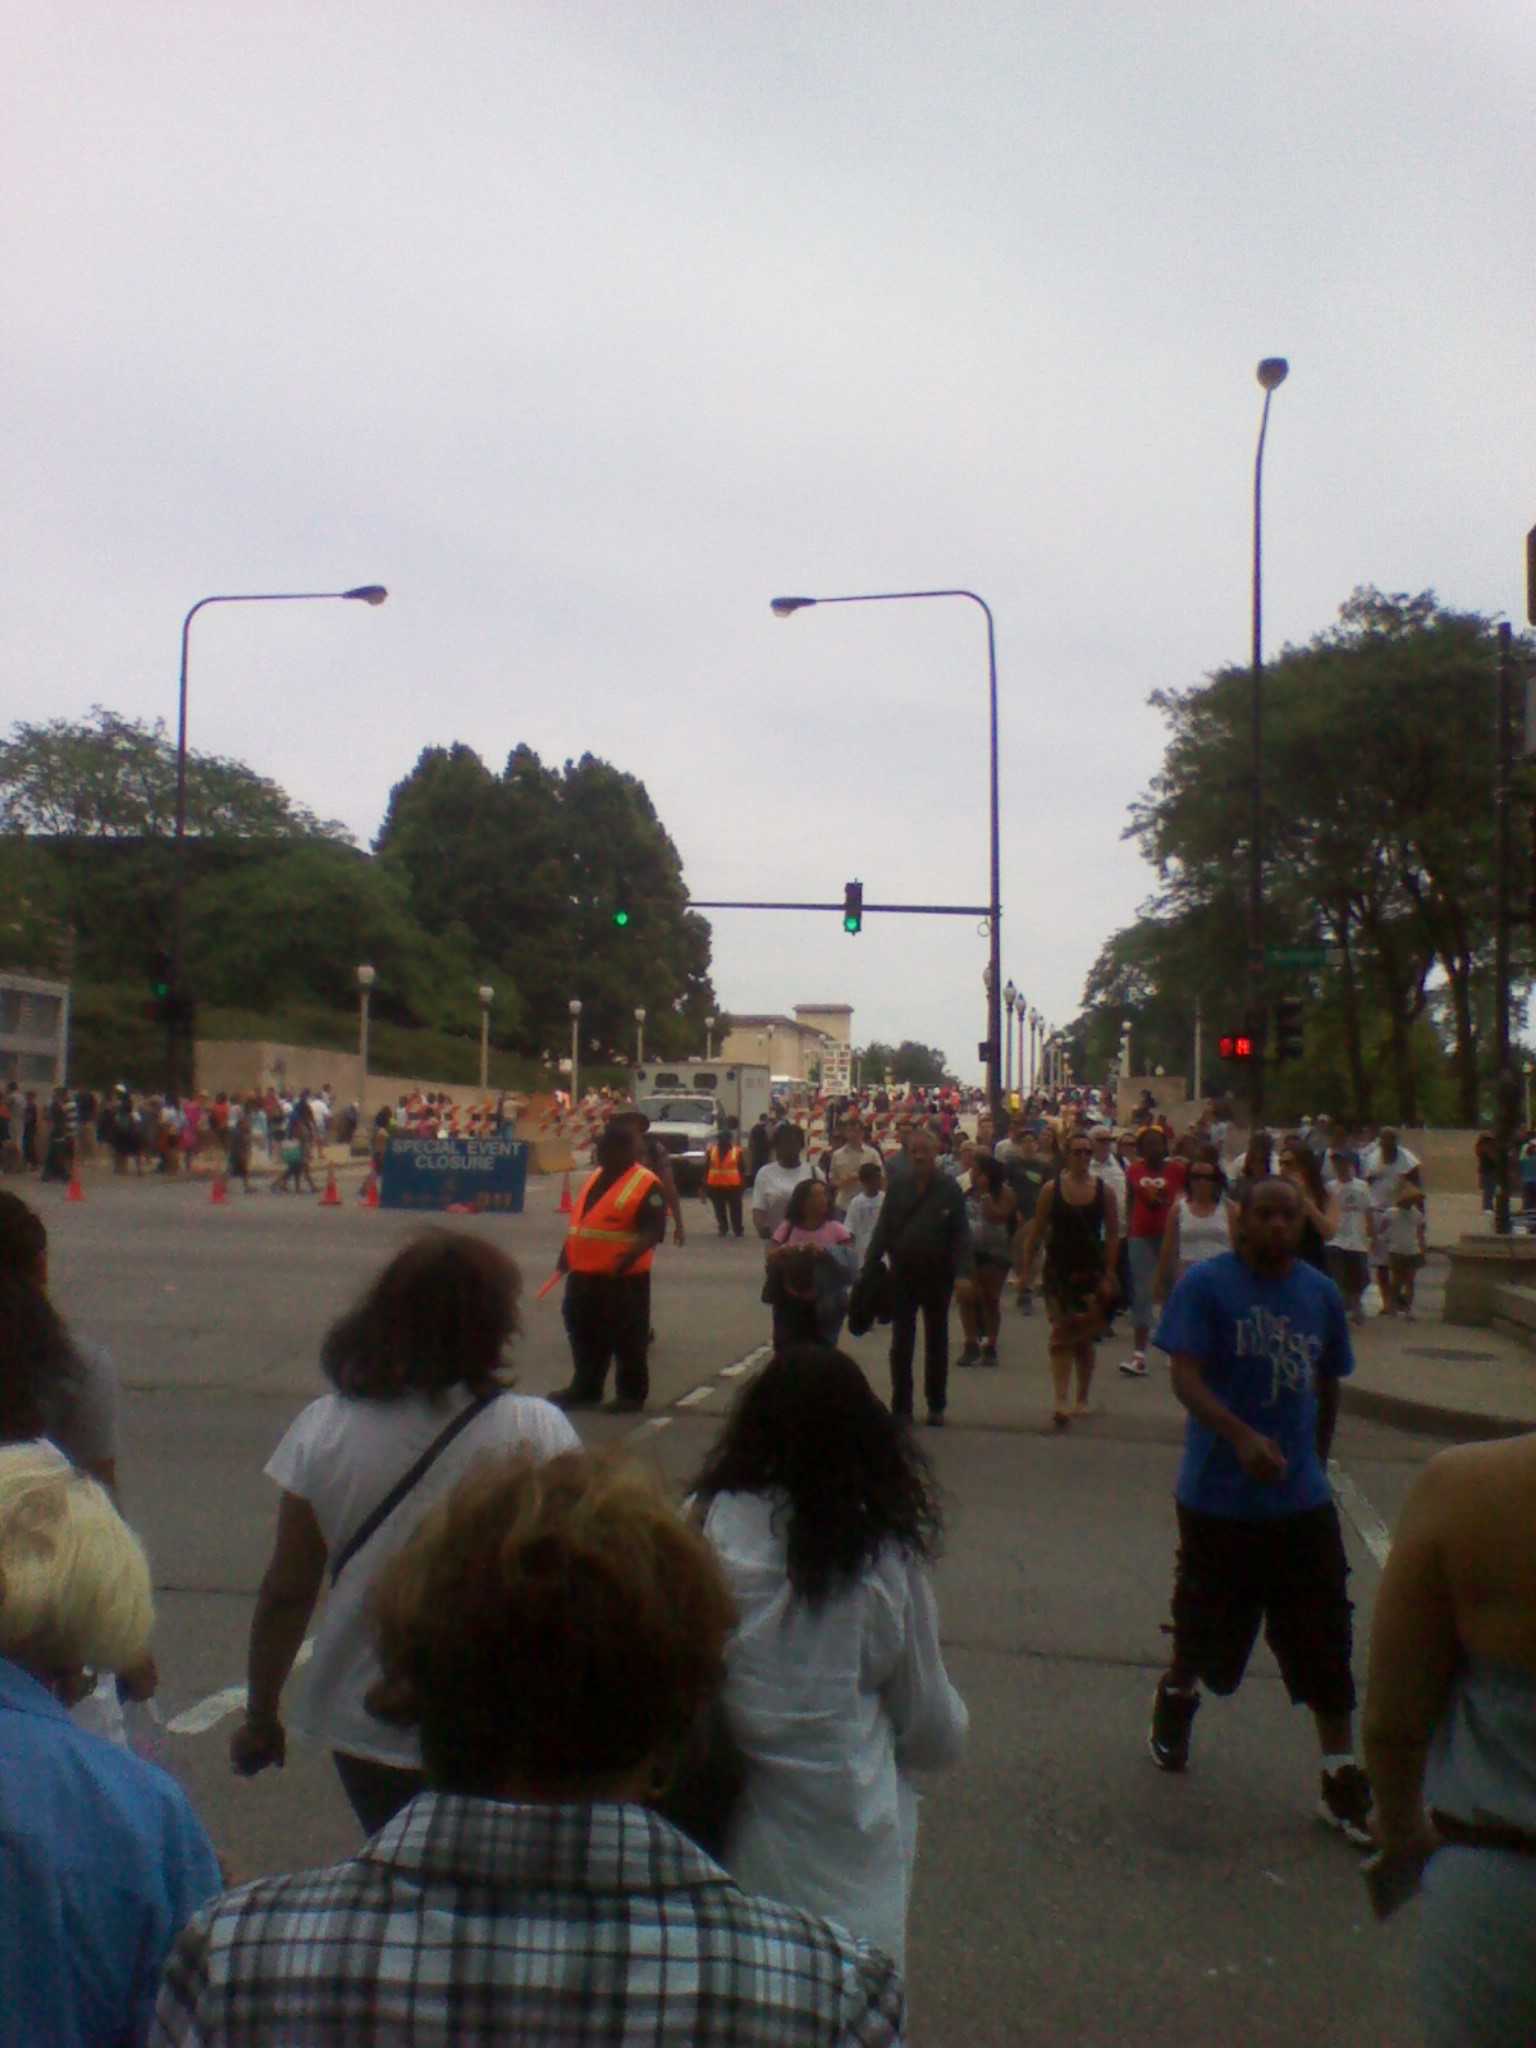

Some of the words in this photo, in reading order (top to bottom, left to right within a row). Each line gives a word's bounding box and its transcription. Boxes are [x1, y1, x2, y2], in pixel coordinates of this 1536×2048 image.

[392, 1140, 461, 1155] SPECIAL
[467, 1141, 522, 1156] EVENT
[415, 1155, 495, 1171] CLOSURE
